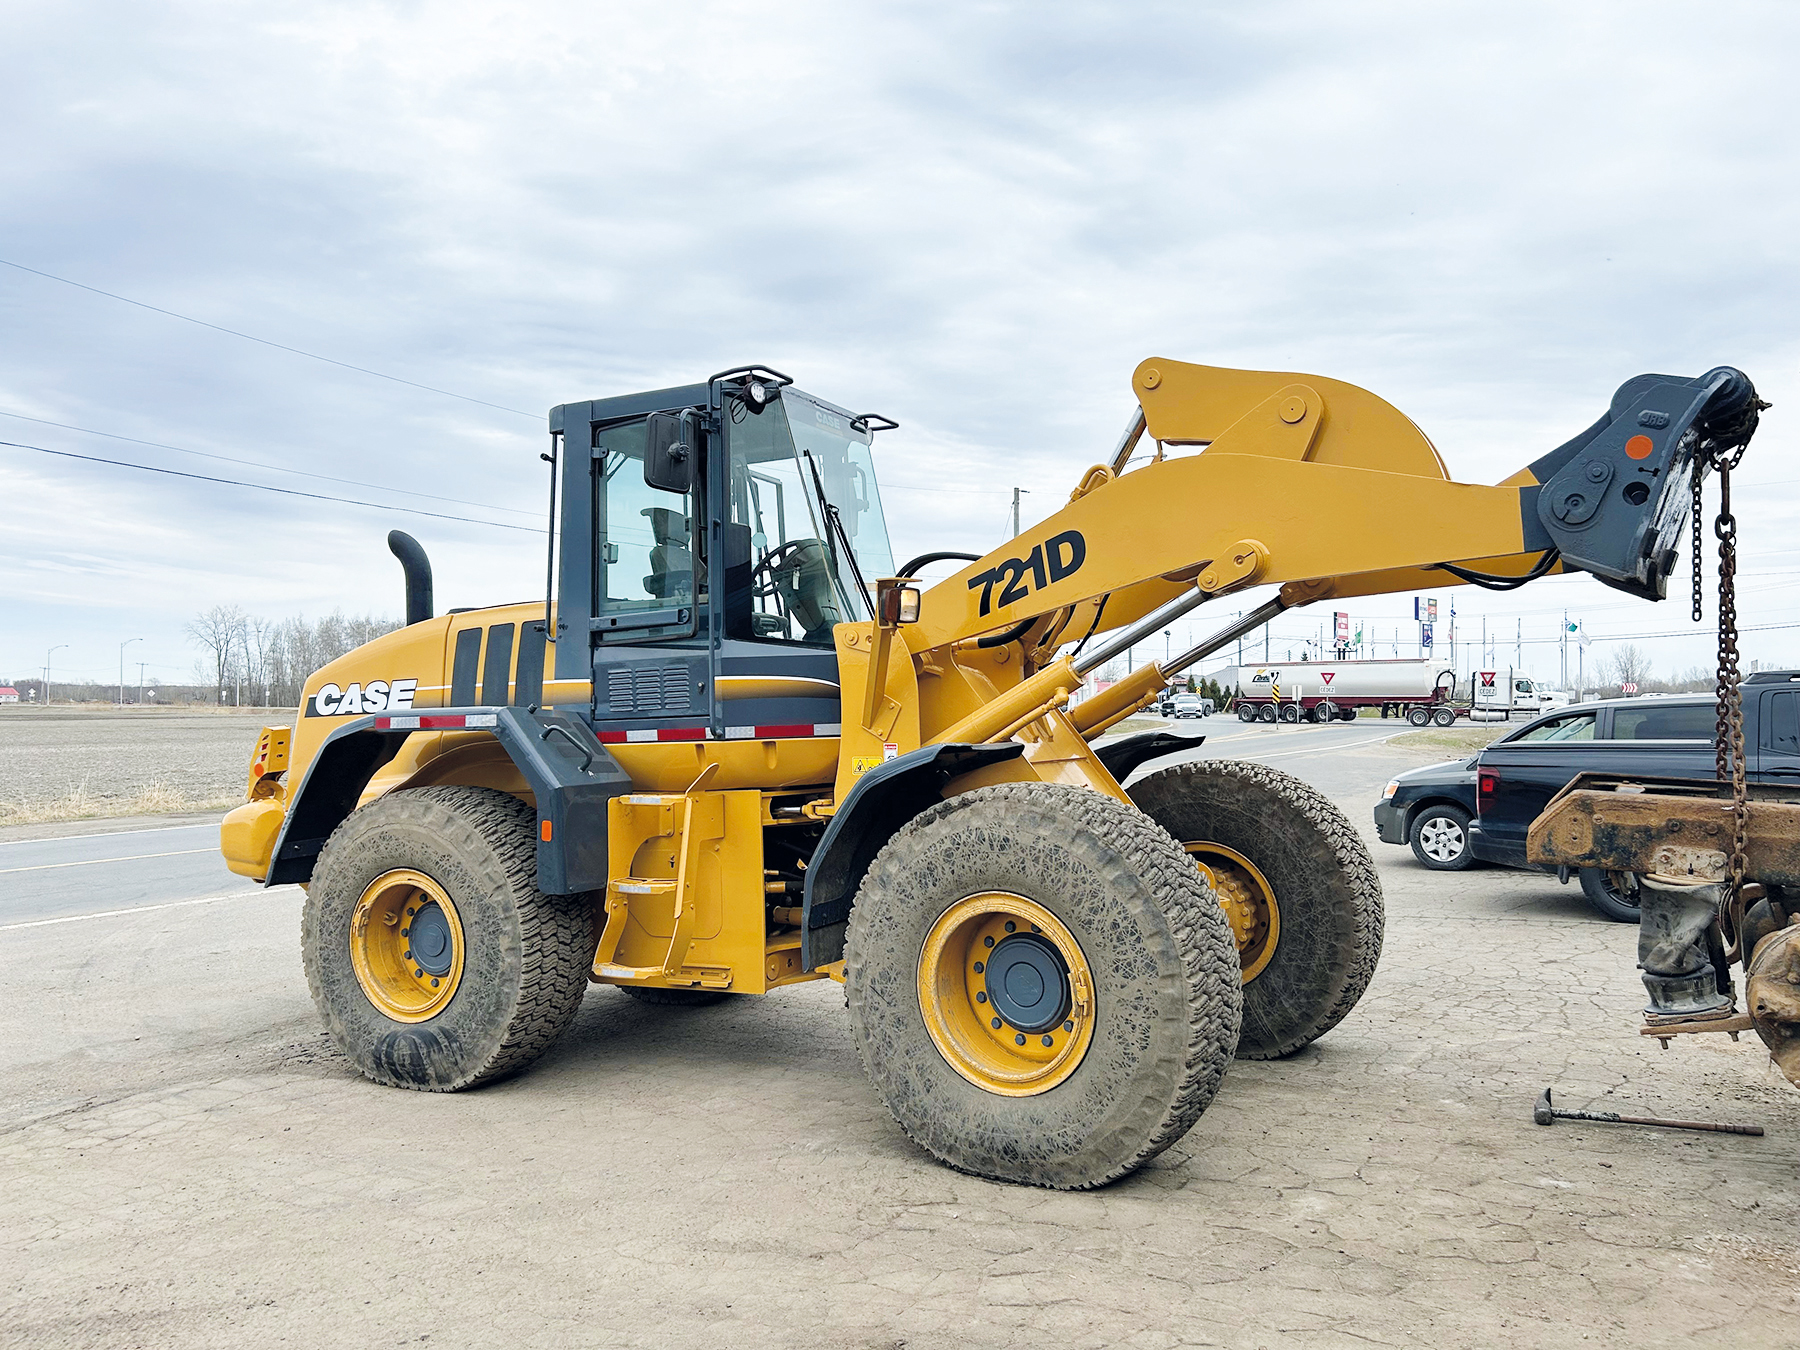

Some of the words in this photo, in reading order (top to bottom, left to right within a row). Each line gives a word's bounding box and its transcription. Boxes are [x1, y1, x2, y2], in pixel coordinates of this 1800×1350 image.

[815, 410, 841, 430] CASE
[1641, 412, 1668, 426] JRB
[967, 530, 1086, 618] 721D
[315, 679, 418, 716] CASE
